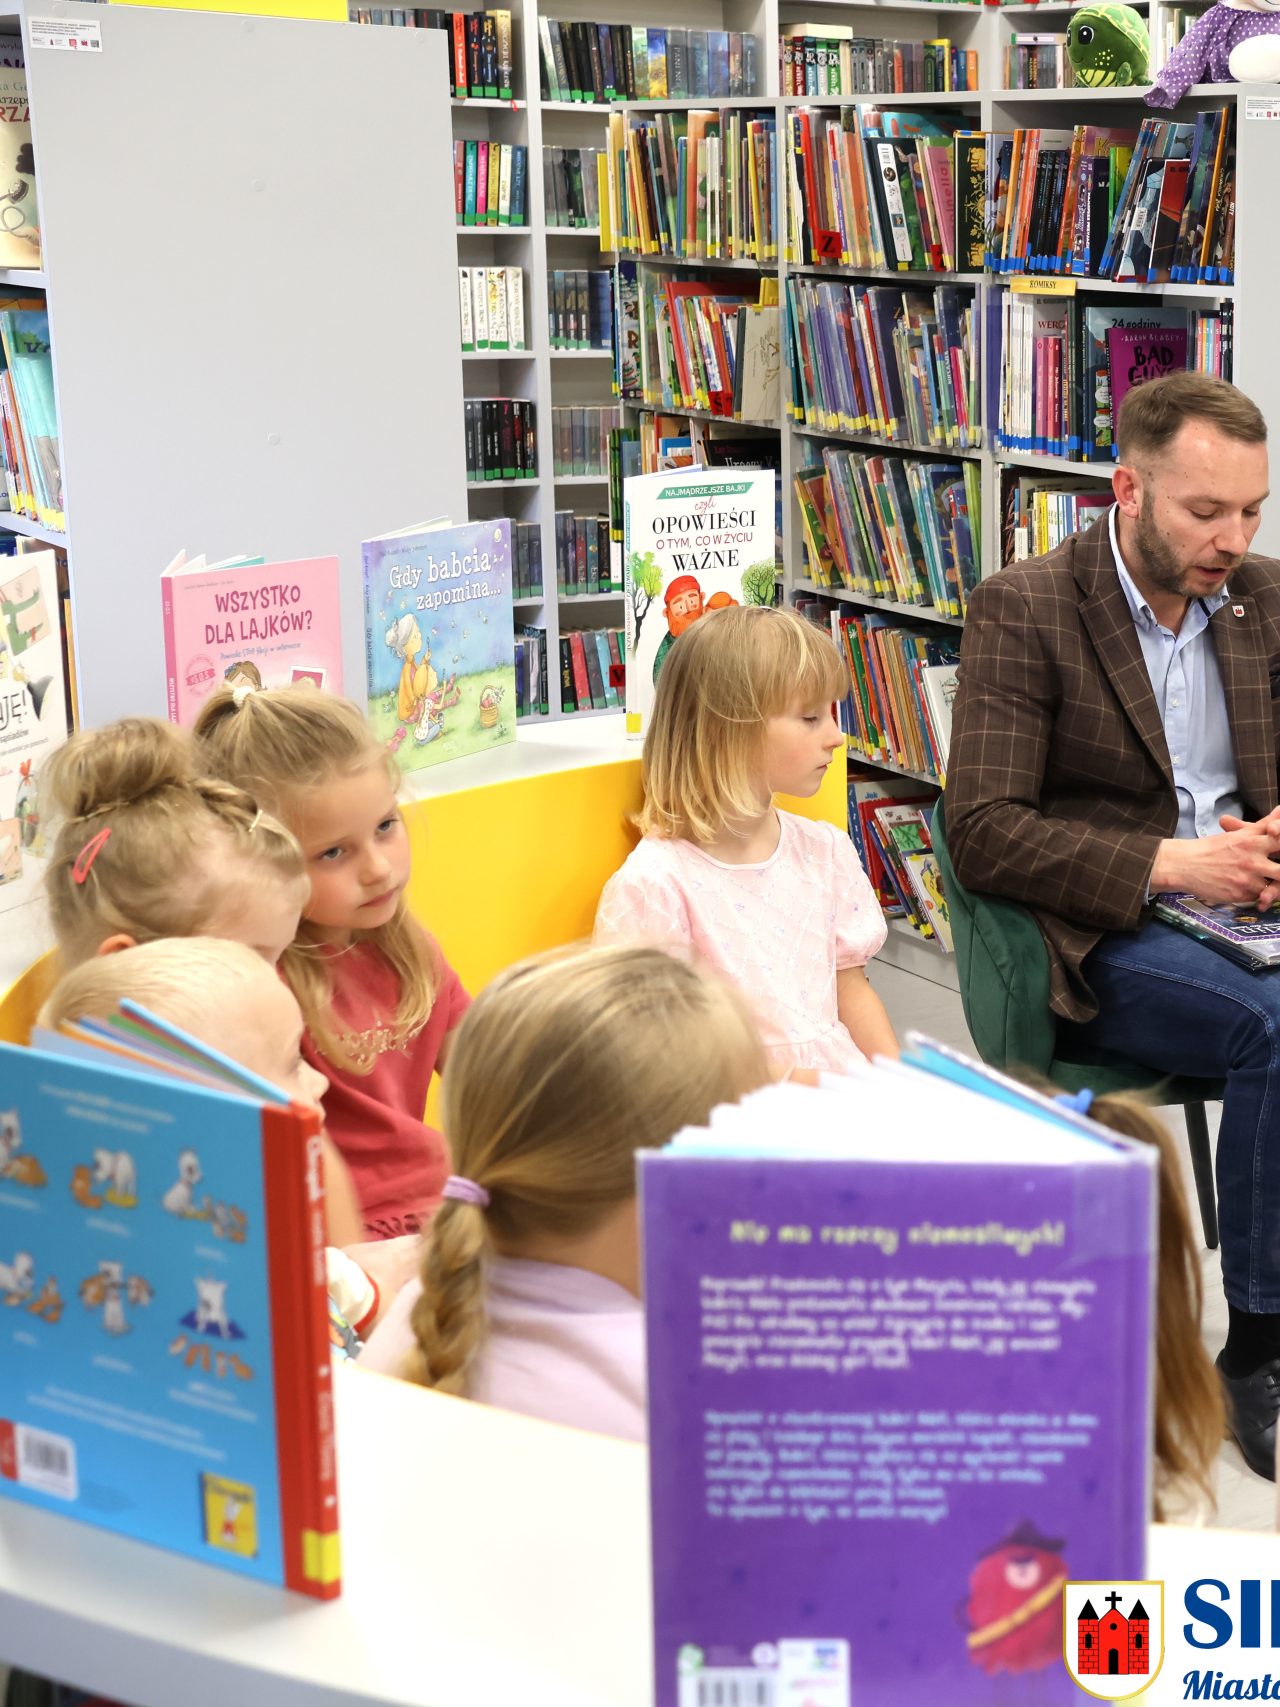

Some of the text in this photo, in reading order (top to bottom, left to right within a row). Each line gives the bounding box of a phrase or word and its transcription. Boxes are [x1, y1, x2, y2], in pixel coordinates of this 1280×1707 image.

[822, 235, 836, 253] Z
[1029, 280, 1057, 289] KOMIKSY
[1111, 318, 1124, 329] 24
[1134, 345, 1174, 366] BAD
[665, 484, 746, 498] NAJMĄDRZEJSZE BAJKI
[695, 496, 717, 515] czyli
[652, 507, 757, 535] OPOWIEŚCI
[656, 531, 754, 550] O TYM, CO W ŻYCIU
[389, 548, 492, 589] Gdy babcia
[671, 548, 740, 573] WAŻNE
[215, 585, 301, 613] WSZYSTKO
[416, 579, 502, 611] zapomina...
[205, 609, 313, 645] DLA LAJKÓW?
